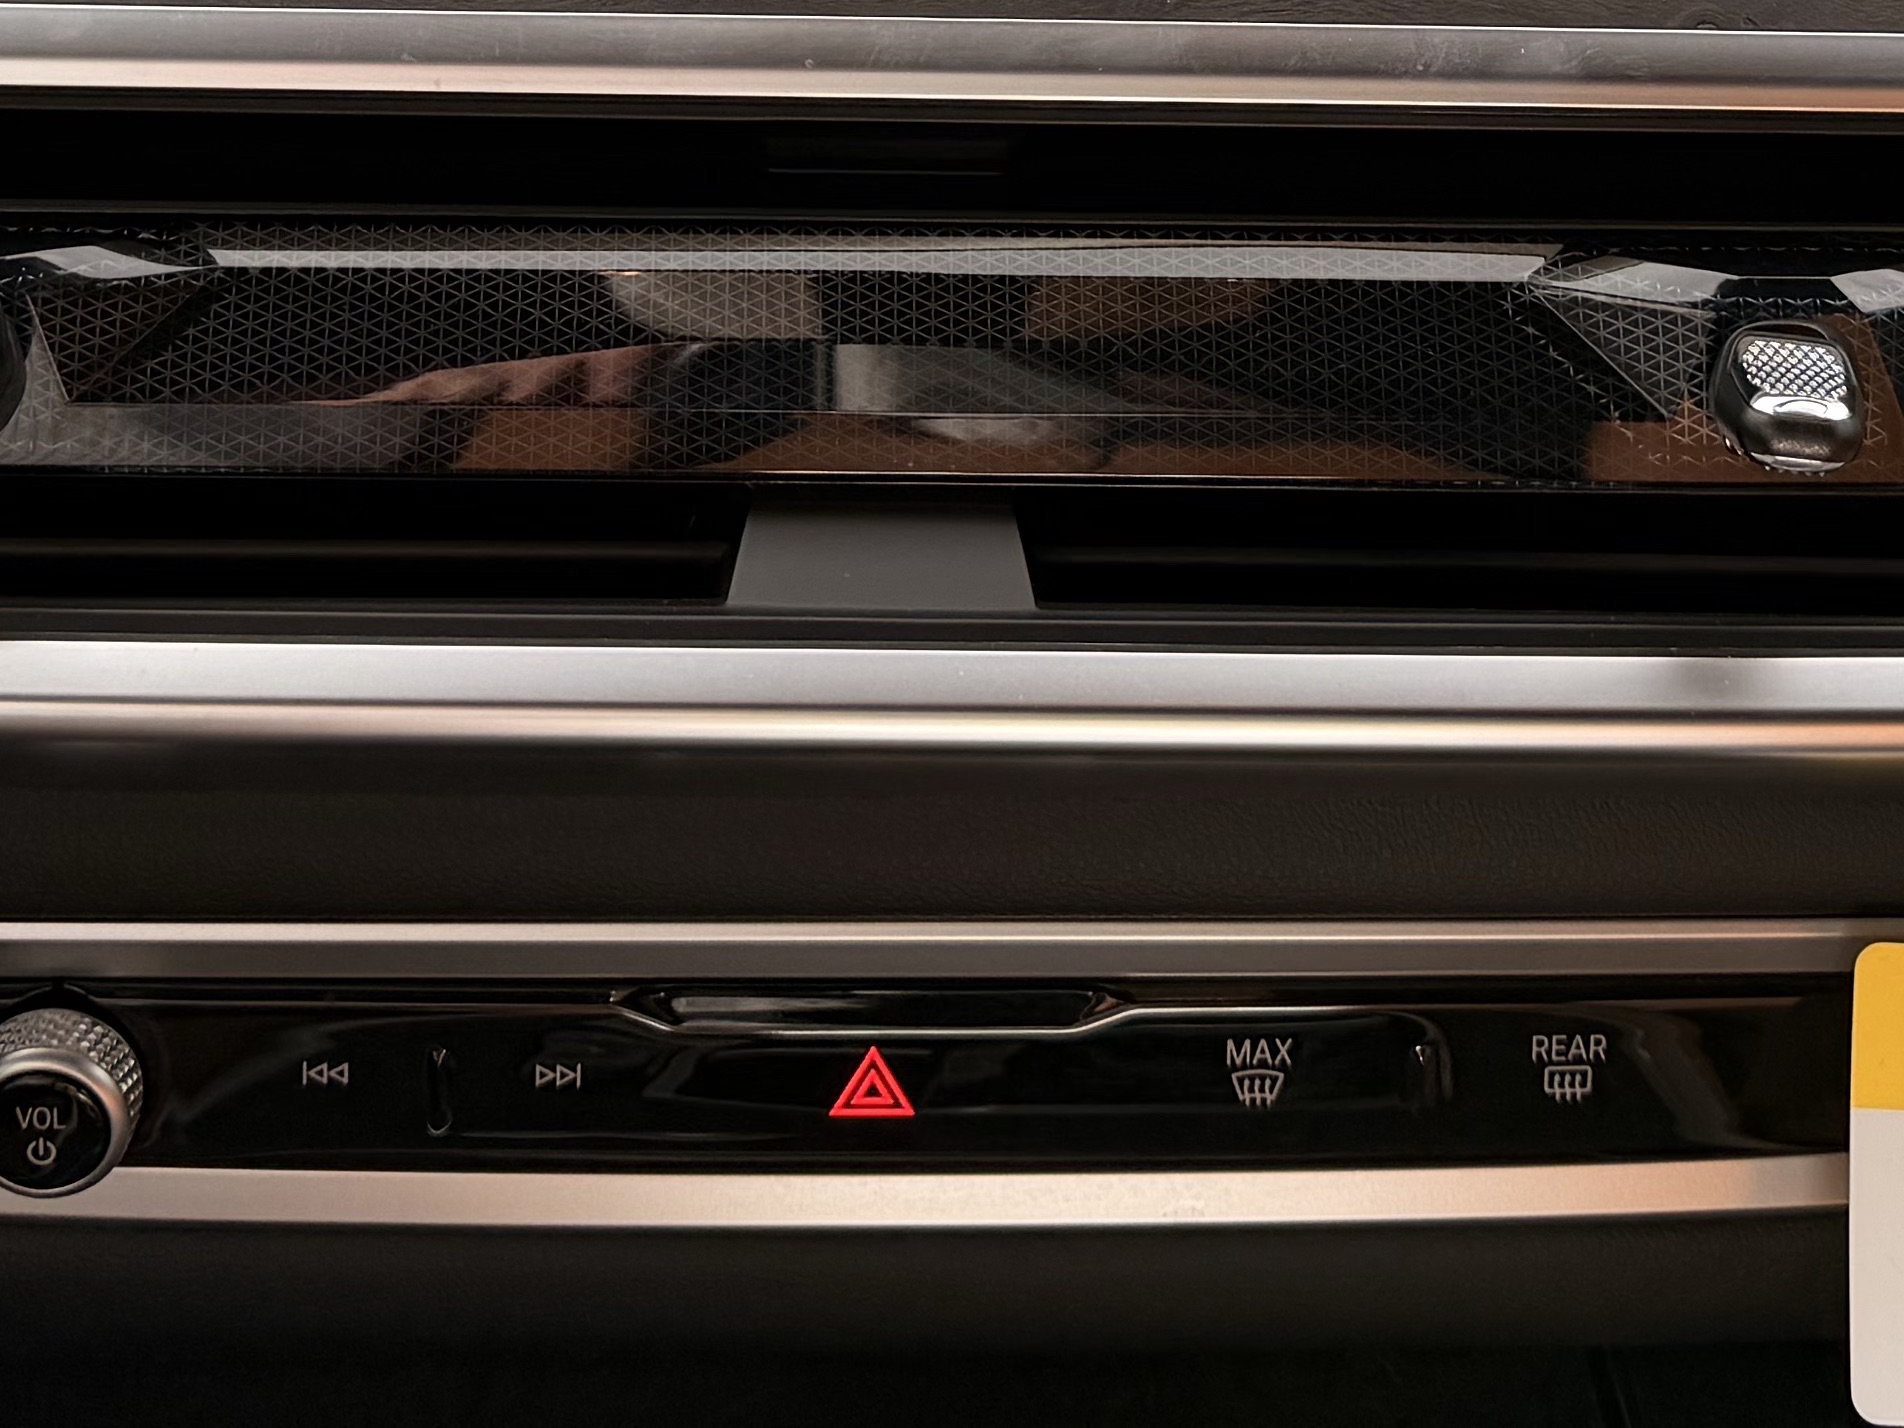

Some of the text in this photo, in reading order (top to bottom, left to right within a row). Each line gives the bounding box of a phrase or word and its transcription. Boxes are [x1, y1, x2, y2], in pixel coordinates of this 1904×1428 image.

[1227, 1038, 1292, 1066] MAX
[1532, 1035, 1606, 1063] REAR
[16, 1107, 66, 1130] VOL
